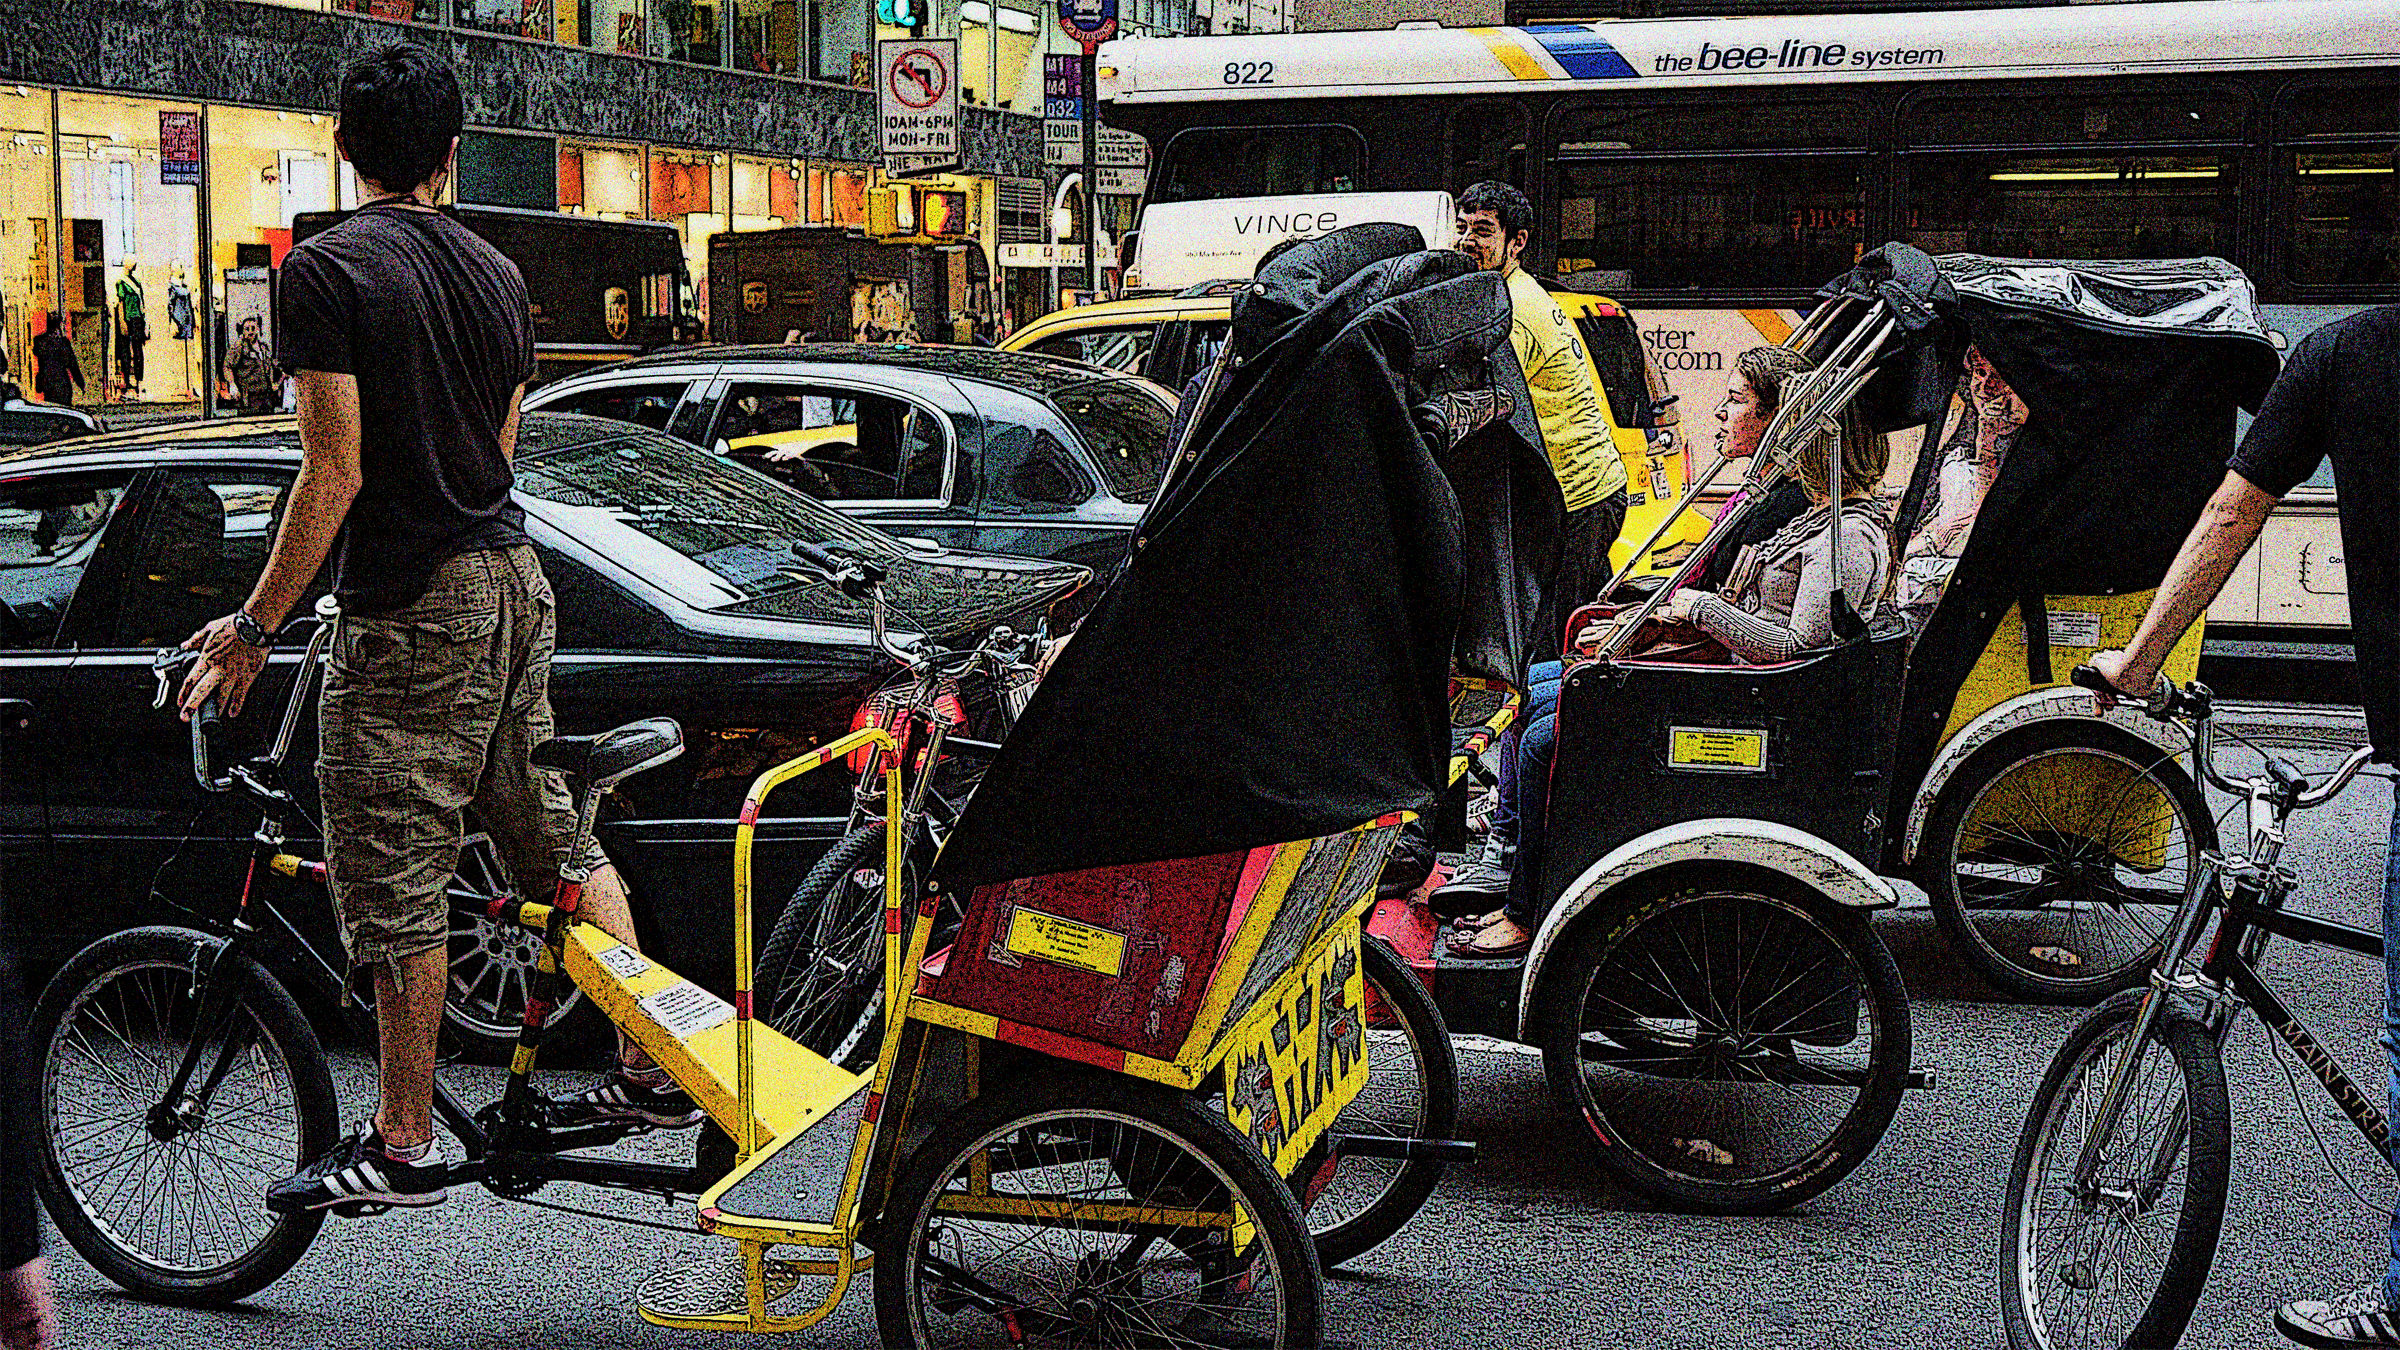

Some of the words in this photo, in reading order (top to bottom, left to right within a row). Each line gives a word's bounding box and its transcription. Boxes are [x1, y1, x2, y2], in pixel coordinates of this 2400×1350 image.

[1655, 54, 1693, 72] the
[1697, 39, 1847, 71] bee-line
[1850, 48, 1944, 69] system
[1223, 61, 1275, 85] 822
[888, 132, 950, 146] MON-FRI
[1047, 124, 1078, 138] TOUR
[1642, 323, 1696, 349] ster
[2276, 1019, 2342, 1084] MAIN
